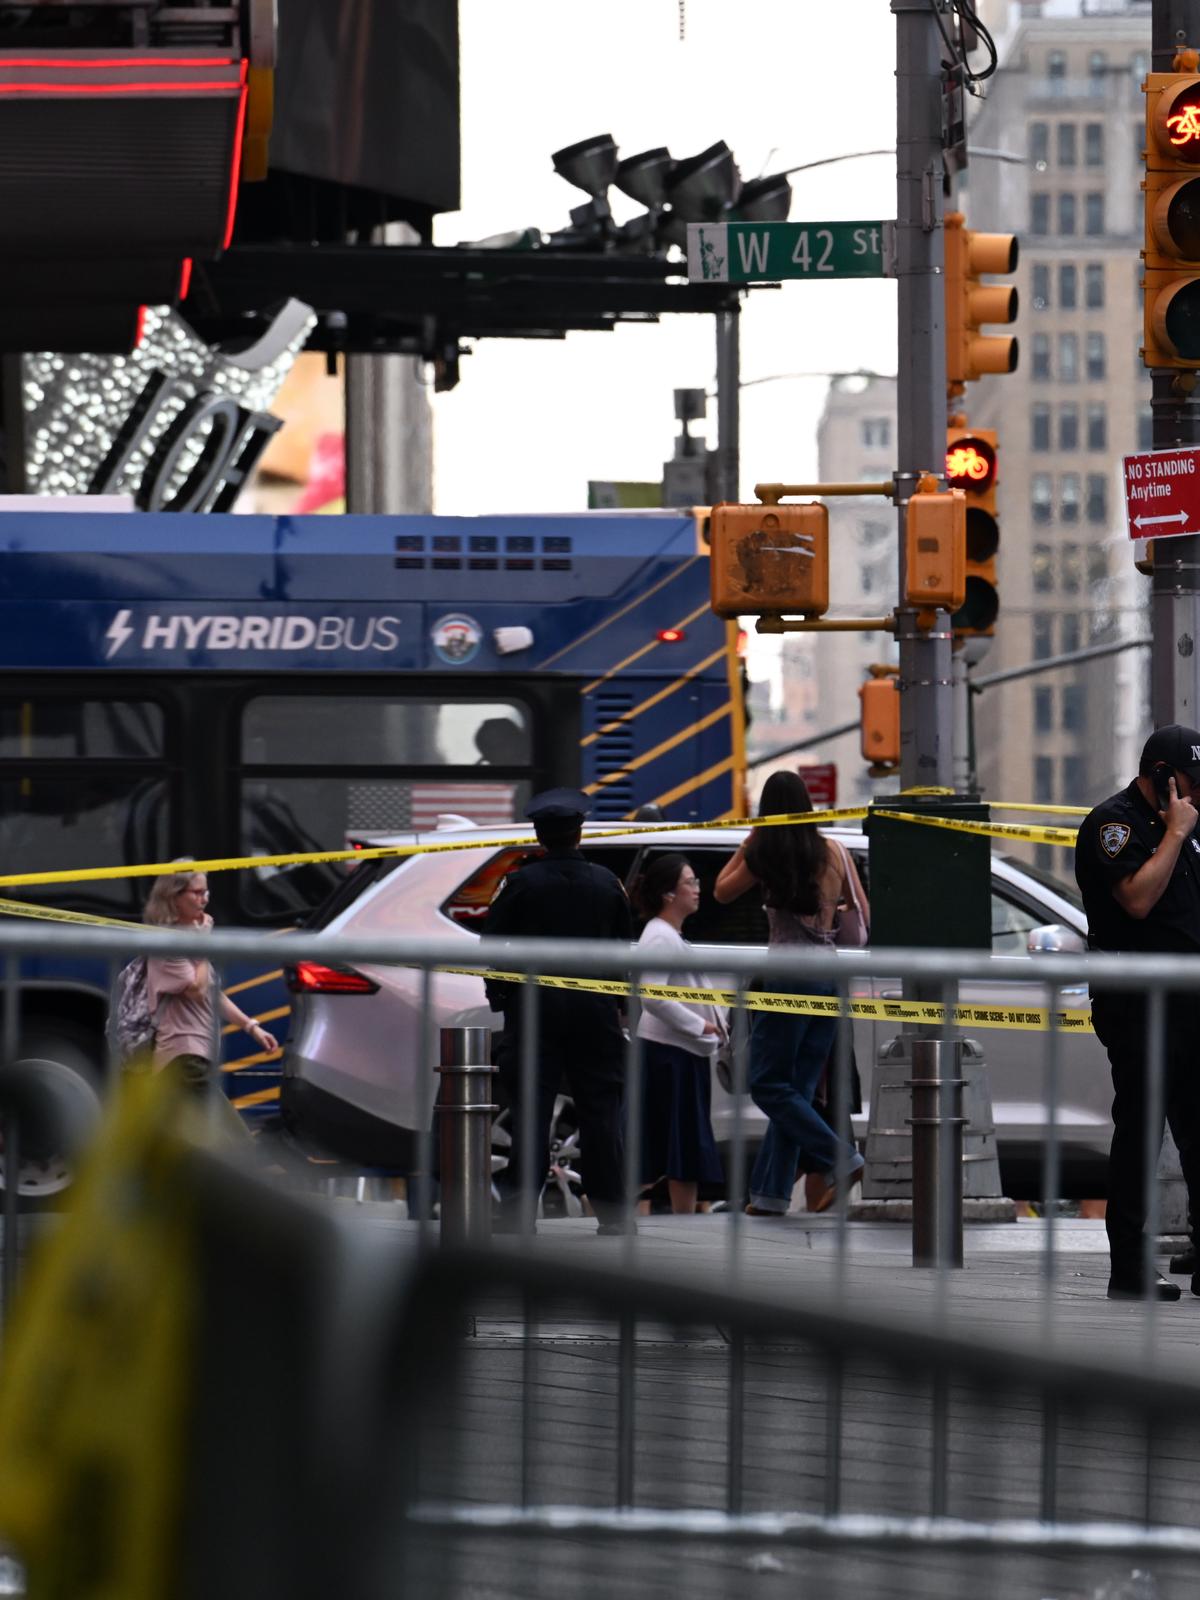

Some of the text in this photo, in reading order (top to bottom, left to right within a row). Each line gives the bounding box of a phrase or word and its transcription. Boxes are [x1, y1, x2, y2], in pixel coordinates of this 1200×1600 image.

[737, 228, 880, 274] W 42 St
[1128, 458, 1196, 479] NO STANDING
[1130, 482, 1172, 502] Anytime
[141, 615, 402, 651] HYBRIDBUS
